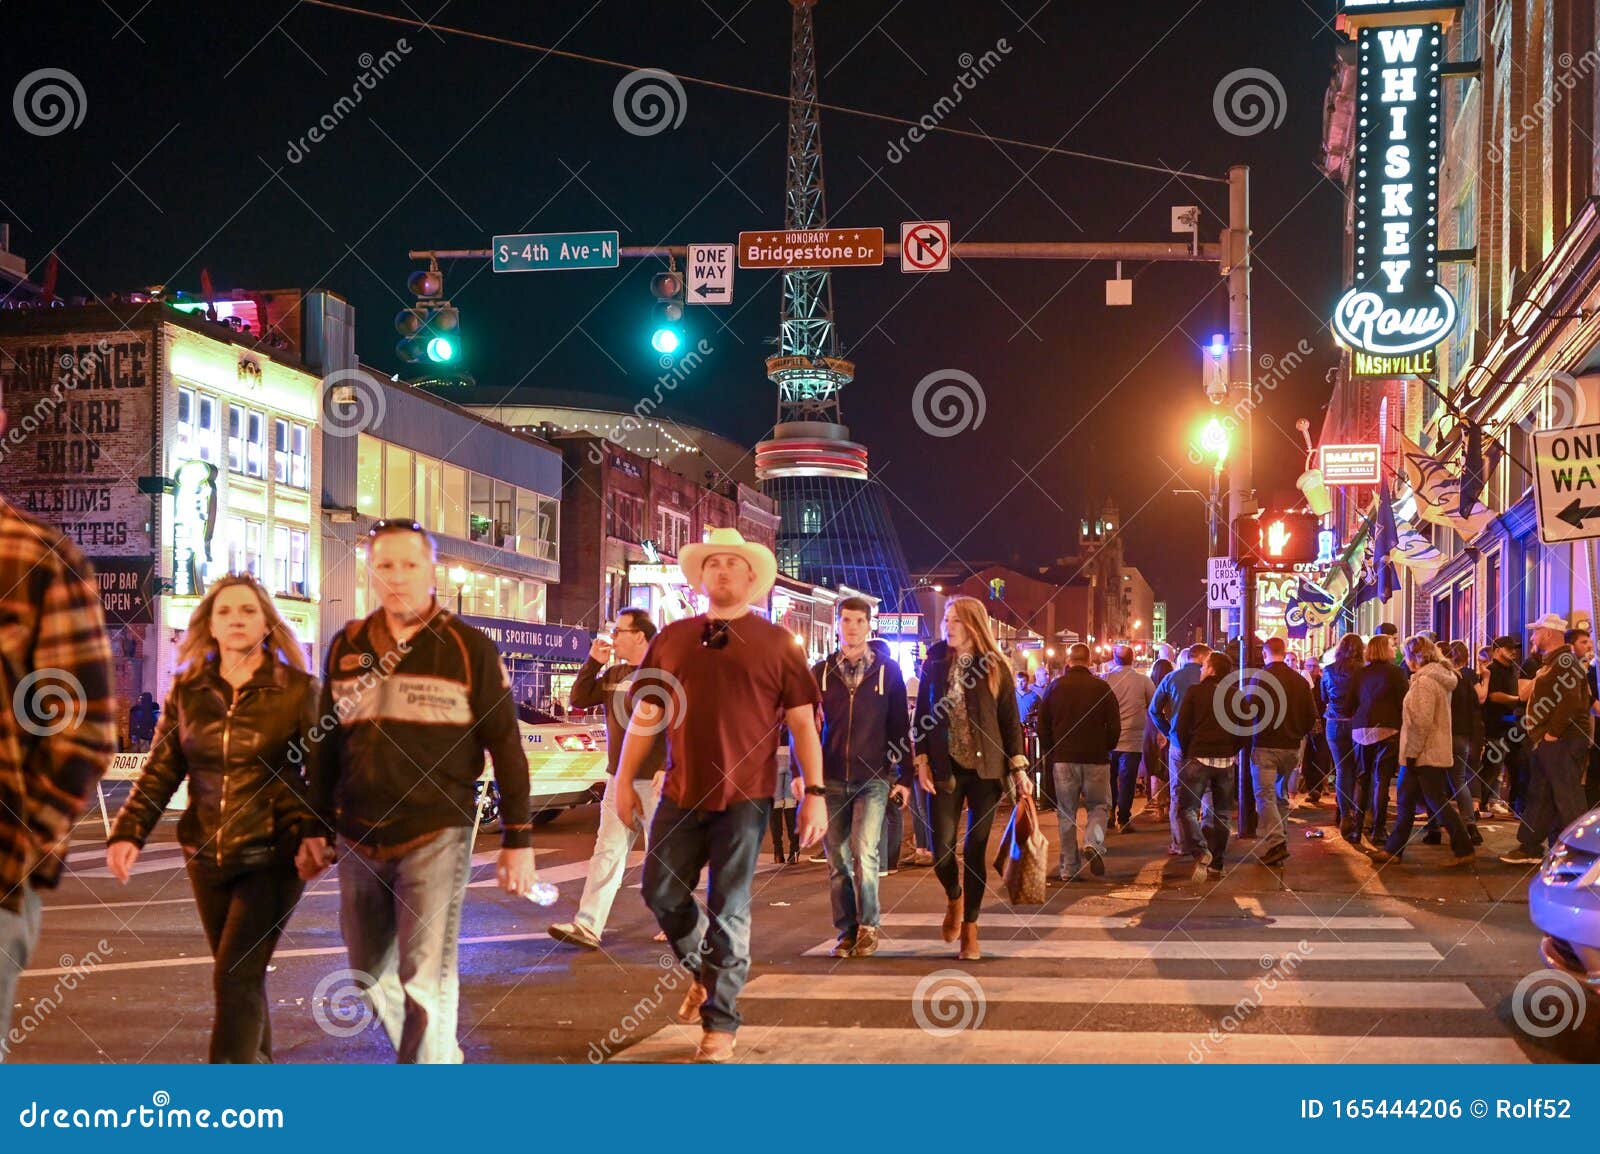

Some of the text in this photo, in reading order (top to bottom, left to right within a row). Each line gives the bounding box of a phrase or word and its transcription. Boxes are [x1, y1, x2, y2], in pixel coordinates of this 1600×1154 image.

[1377, 28, 1423, 293] WHISKEY
[785, 232, 830, 244] HONORARY
[695, 249, 726, 263] ONE
[747, 244, 874, 264] Bridgestone Dr
[694, 265, 727, 279] WAY
[1345, 291, 1445, 340] Row
[1355, 350, 1433, 374] NASHVILLE
[37, 438, 100, 473] SHOP
[28, 488, 112, 512] ALBUMS
[119, 572, 138, 590] BAR
[1210, 582, 1229, 601] OK
[104, 594, 131, 611] OPEN
[505, 629, 542, 647] SPORTING
[545, 634, 563, 648] CLUB
[527, 734, 542, 743] 911
[112, 756, 139, 769] ROAD
